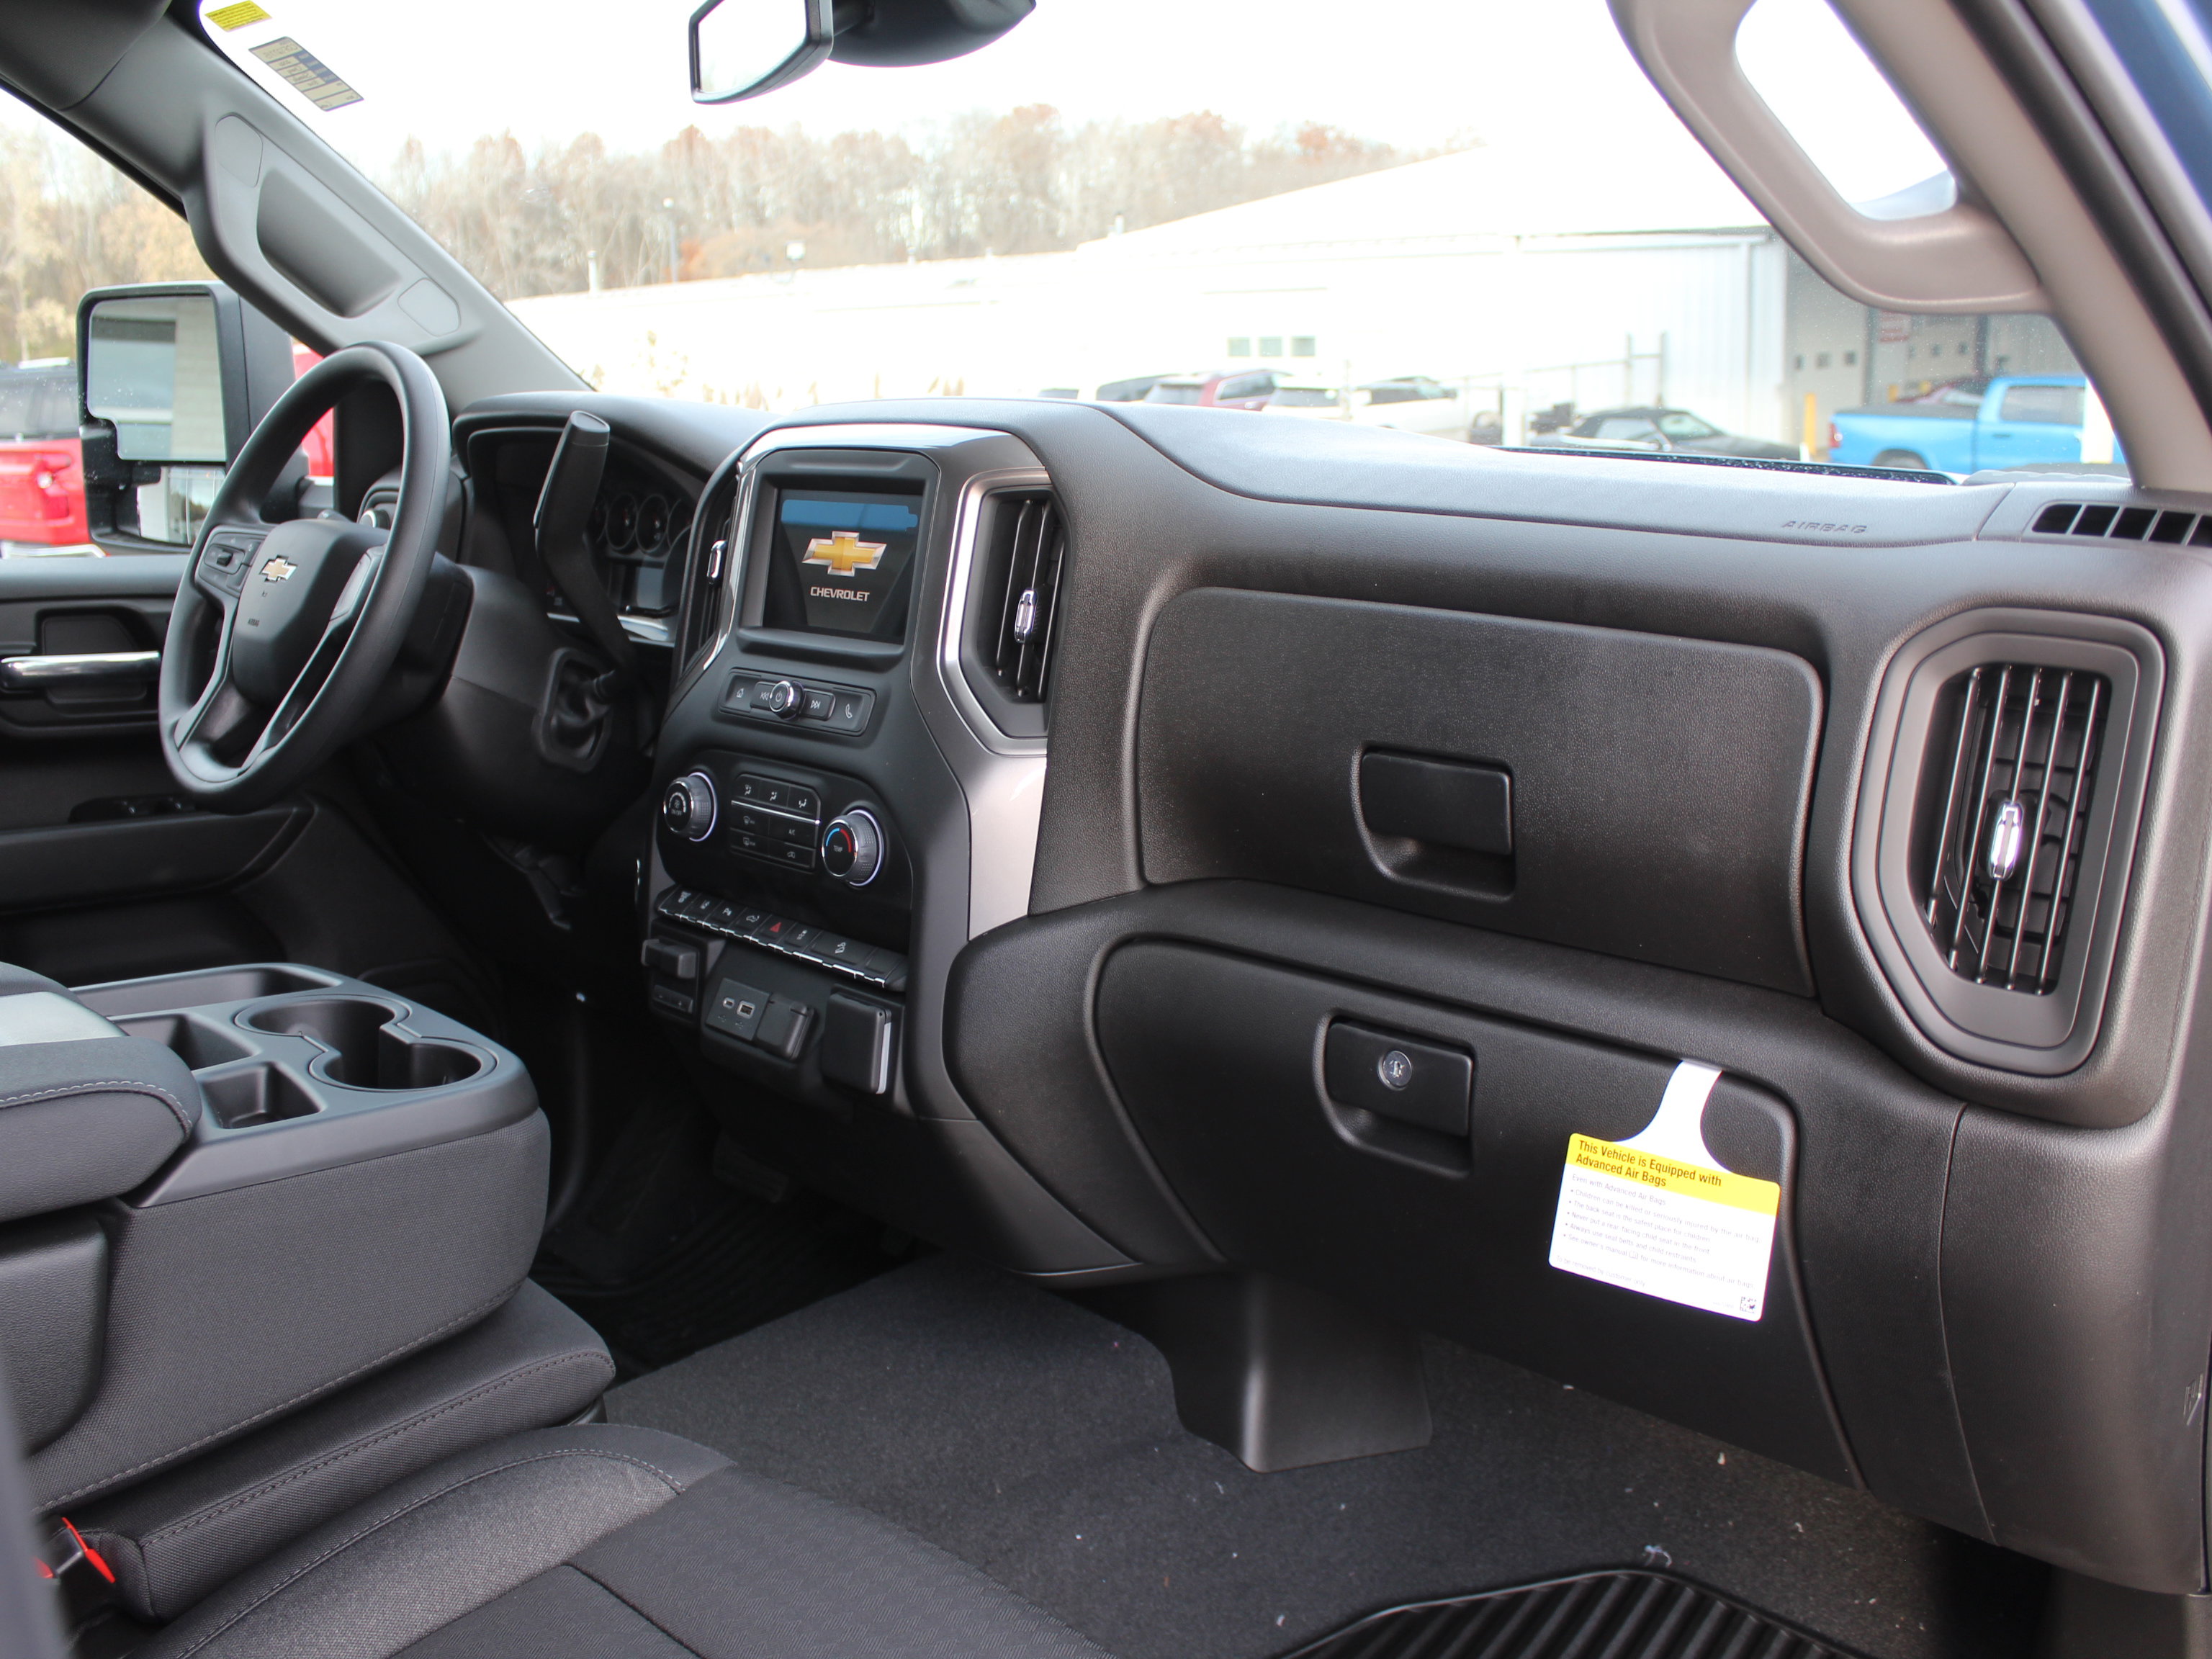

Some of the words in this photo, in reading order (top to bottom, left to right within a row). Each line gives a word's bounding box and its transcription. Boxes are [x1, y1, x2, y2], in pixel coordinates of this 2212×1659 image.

[1781, 521, 1867, 534] AIRBAG
[810, 586, 870, 601] CHEVROLET
[1575, 1153, 1623, 1175] Advanced
[1624, 1166, 1640, 1179] Air
[1642, 1170, 1666, 1187] Bags
[1579, 1140, 1598, 1154] This
[1601, 1146, 1636, 1164] Vehicle
[1638, 1158, 1647, 1167] is
[1649, 1159, 1696, 1180] Equipped
[1699, 1174, 1722, 1187] with
